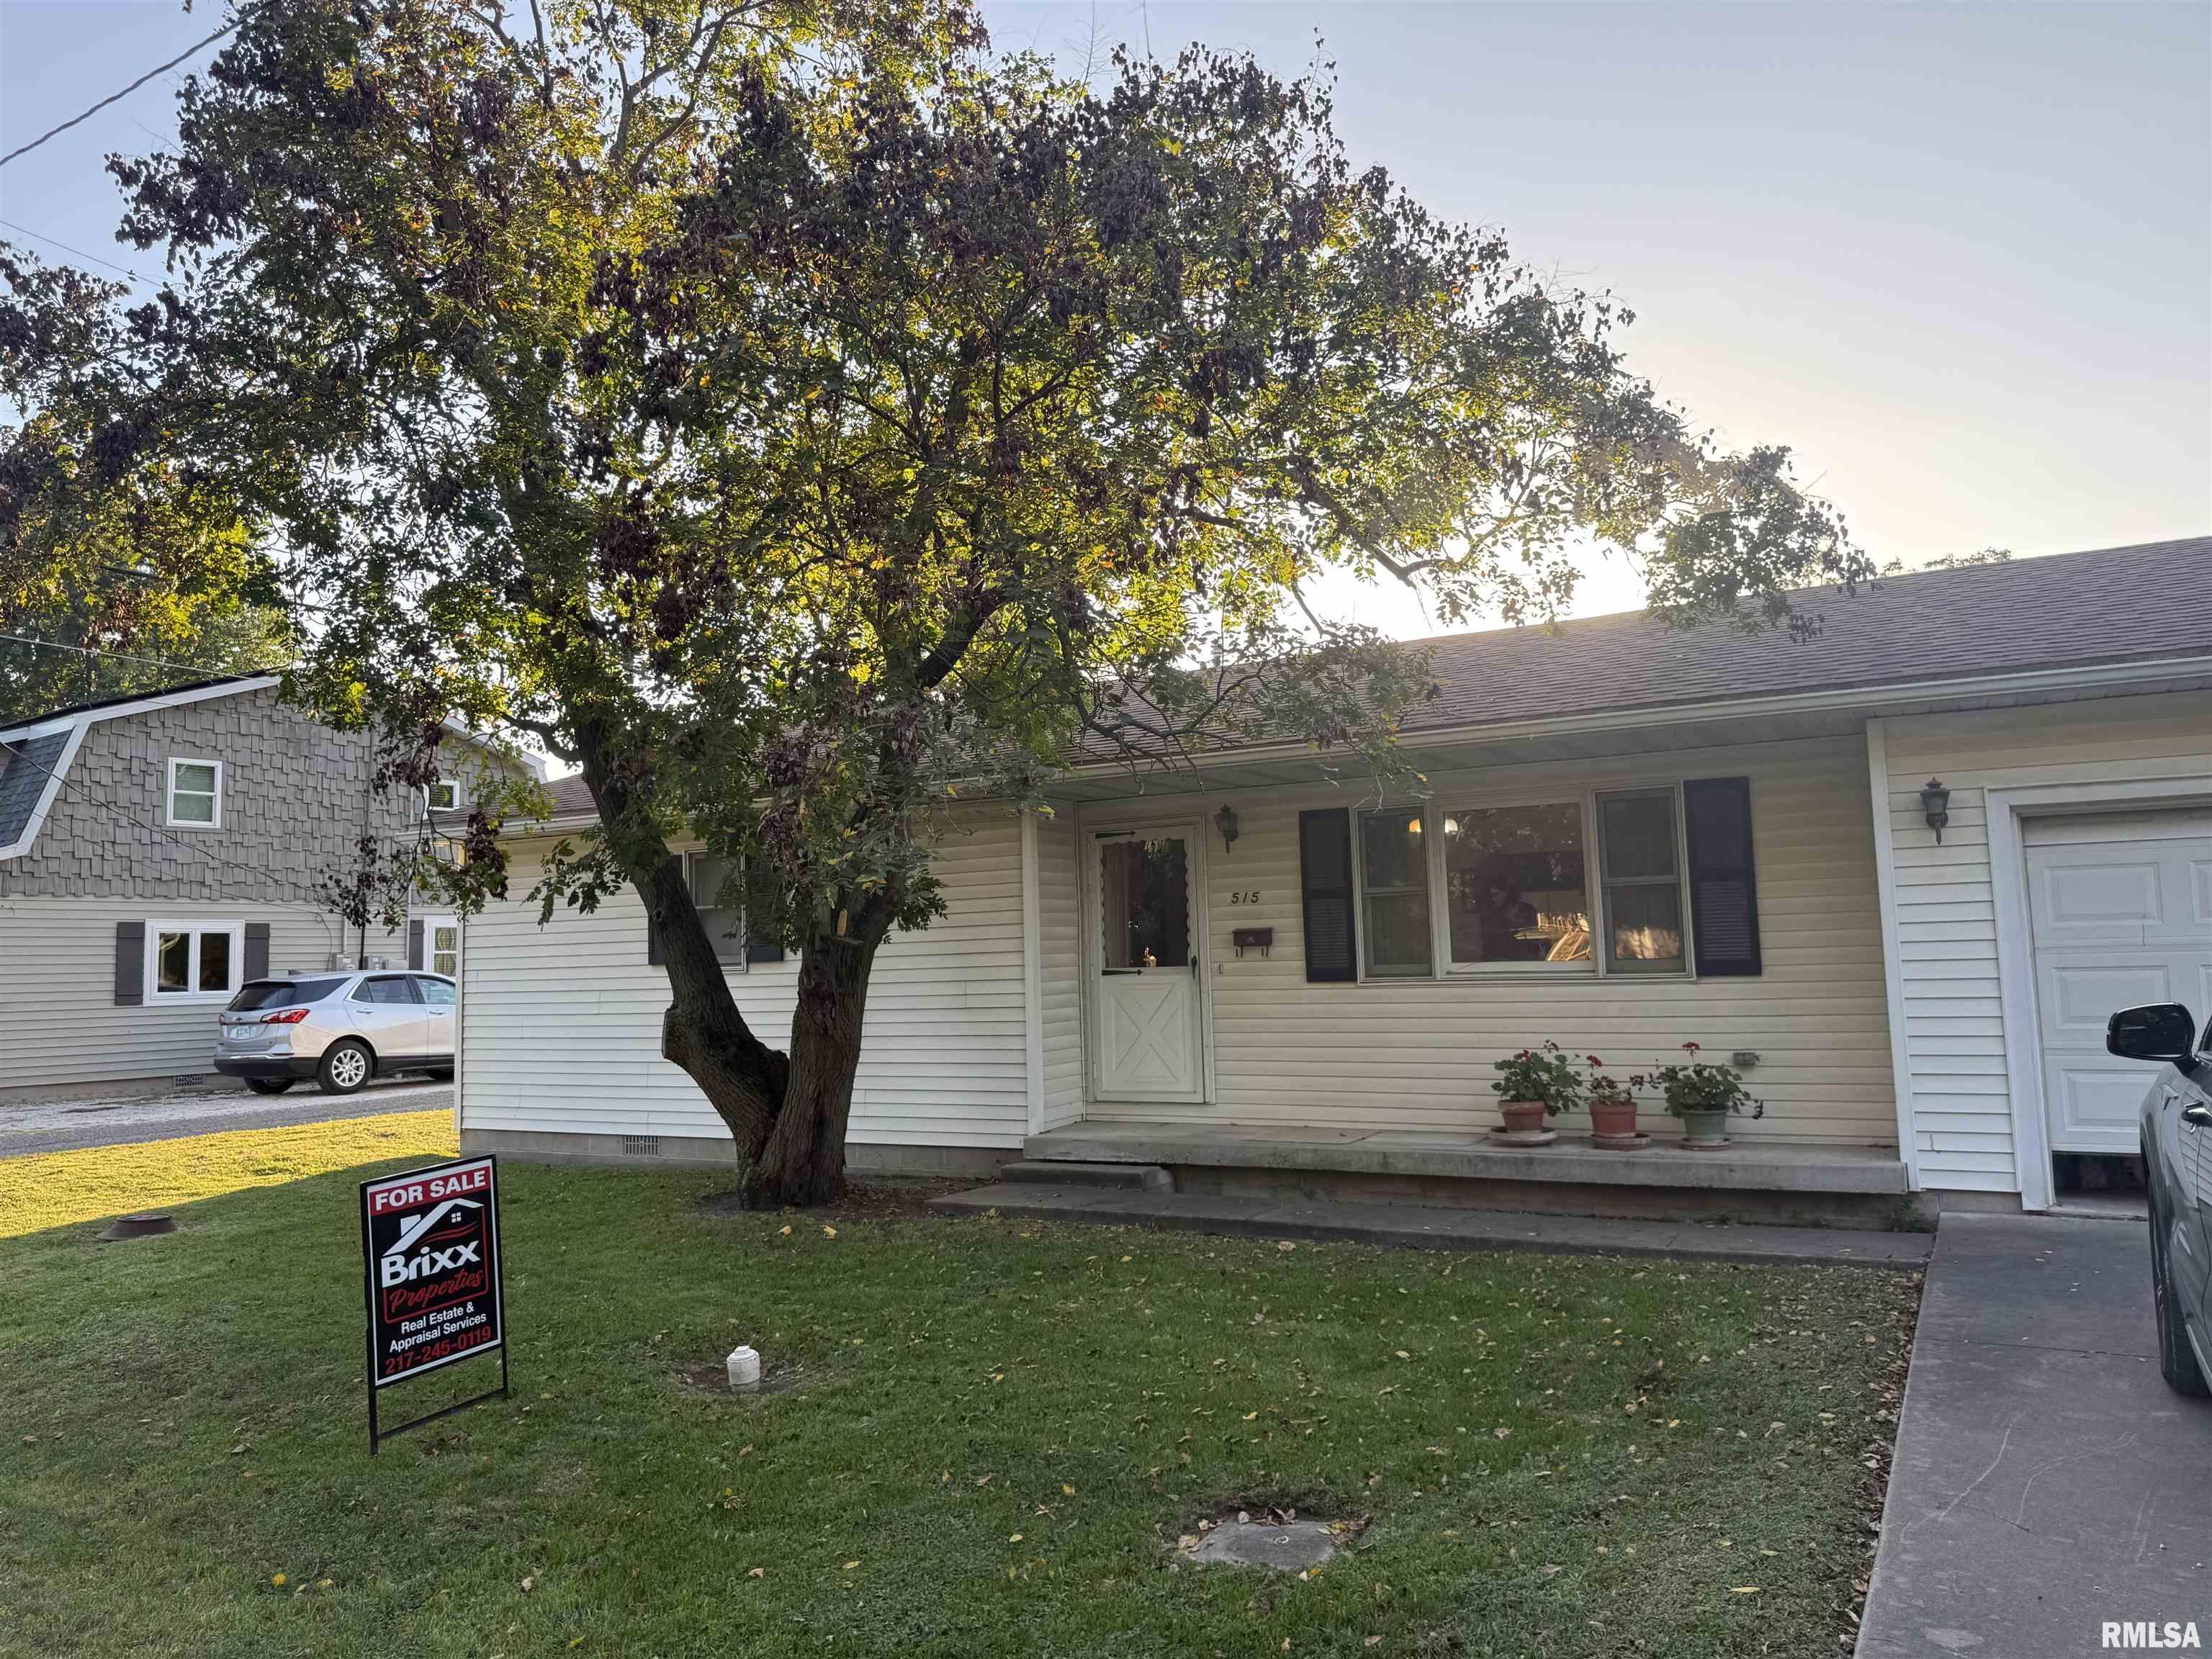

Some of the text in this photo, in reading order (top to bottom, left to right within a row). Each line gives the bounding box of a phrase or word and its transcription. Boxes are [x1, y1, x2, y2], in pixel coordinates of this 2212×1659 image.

[1231, 892, 1259, 904] 515
[375, 1170, 486, 1212] FOR SALE
[382, 1240, 481, 1288] Brixx
[389, 1267, 484, 1313] Properties
[390, 1313, 487, 1353] Appraisal Services
[401, 1302, 475, 1334] Real Estate &
[385, 1326, 492, 1375] 217-245-0119
